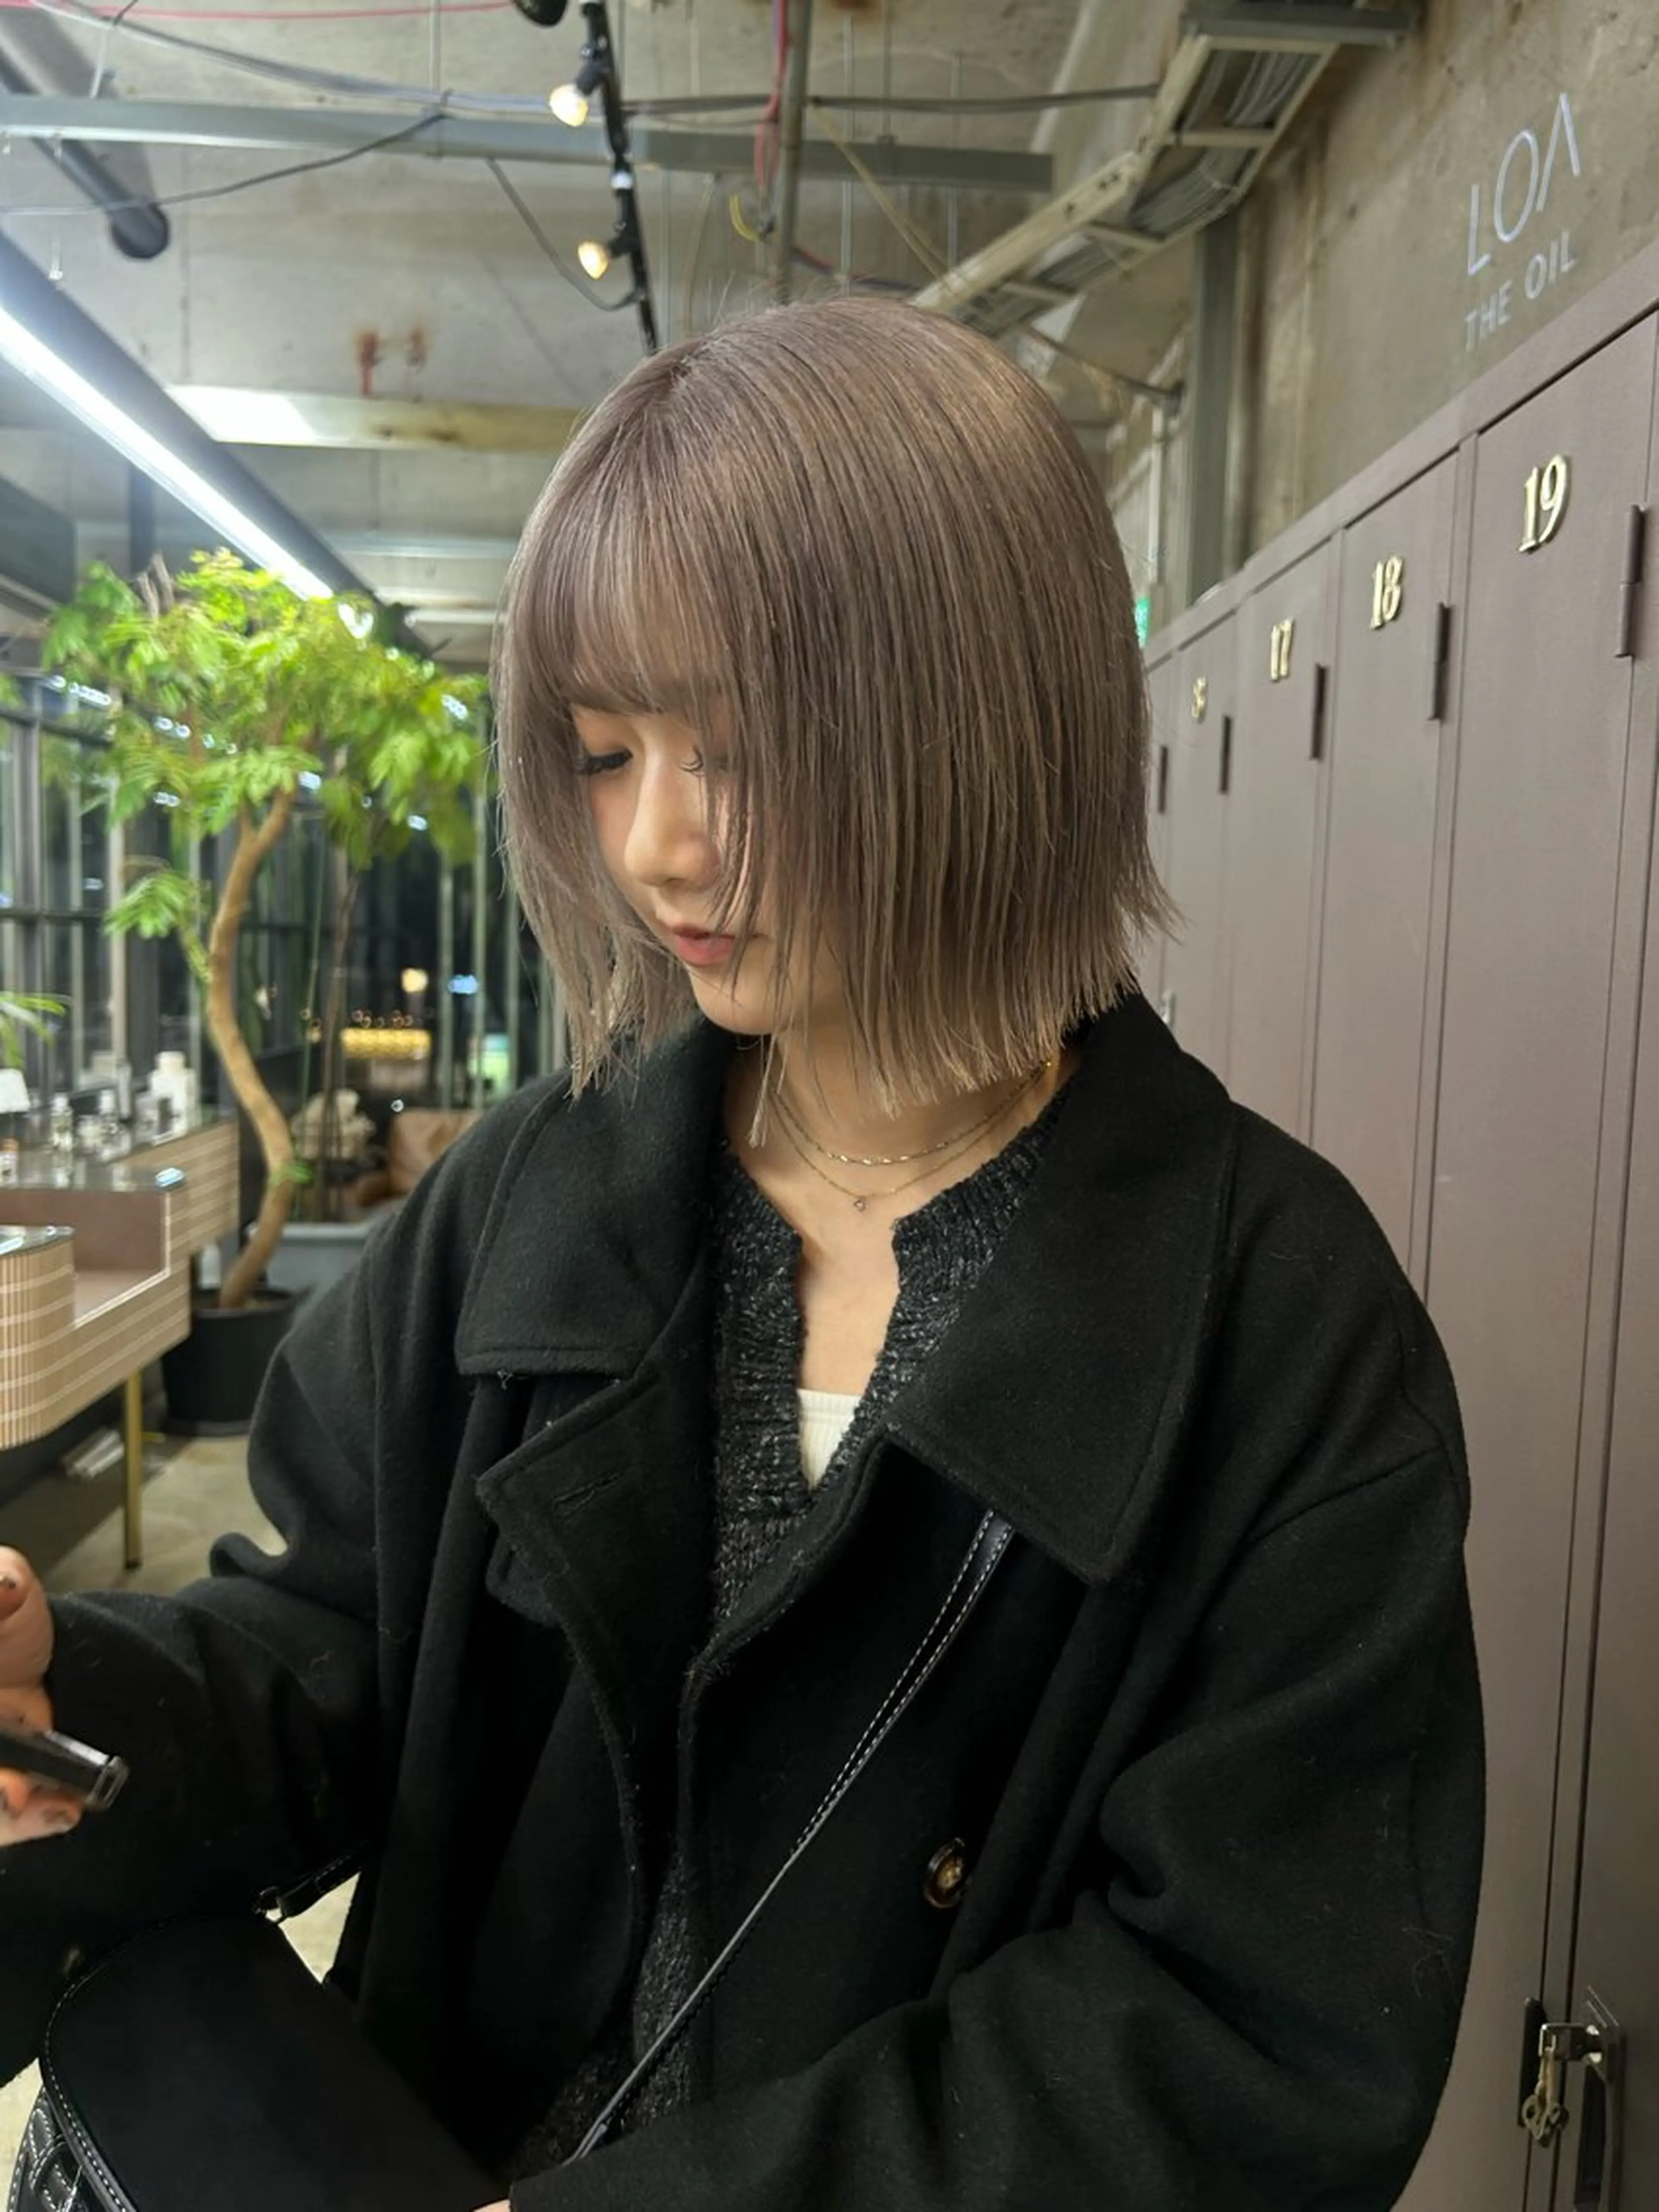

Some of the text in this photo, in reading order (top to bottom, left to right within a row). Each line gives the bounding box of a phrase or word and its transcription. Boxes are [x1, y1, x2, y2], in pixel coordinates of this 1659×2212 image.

[1465, 230, 1577, 352] THE OIL
[1518, 454, 1567, 552] 19
[1370, 556, 1403, 628] 18
[1271, 618, 1292, 680] 17
